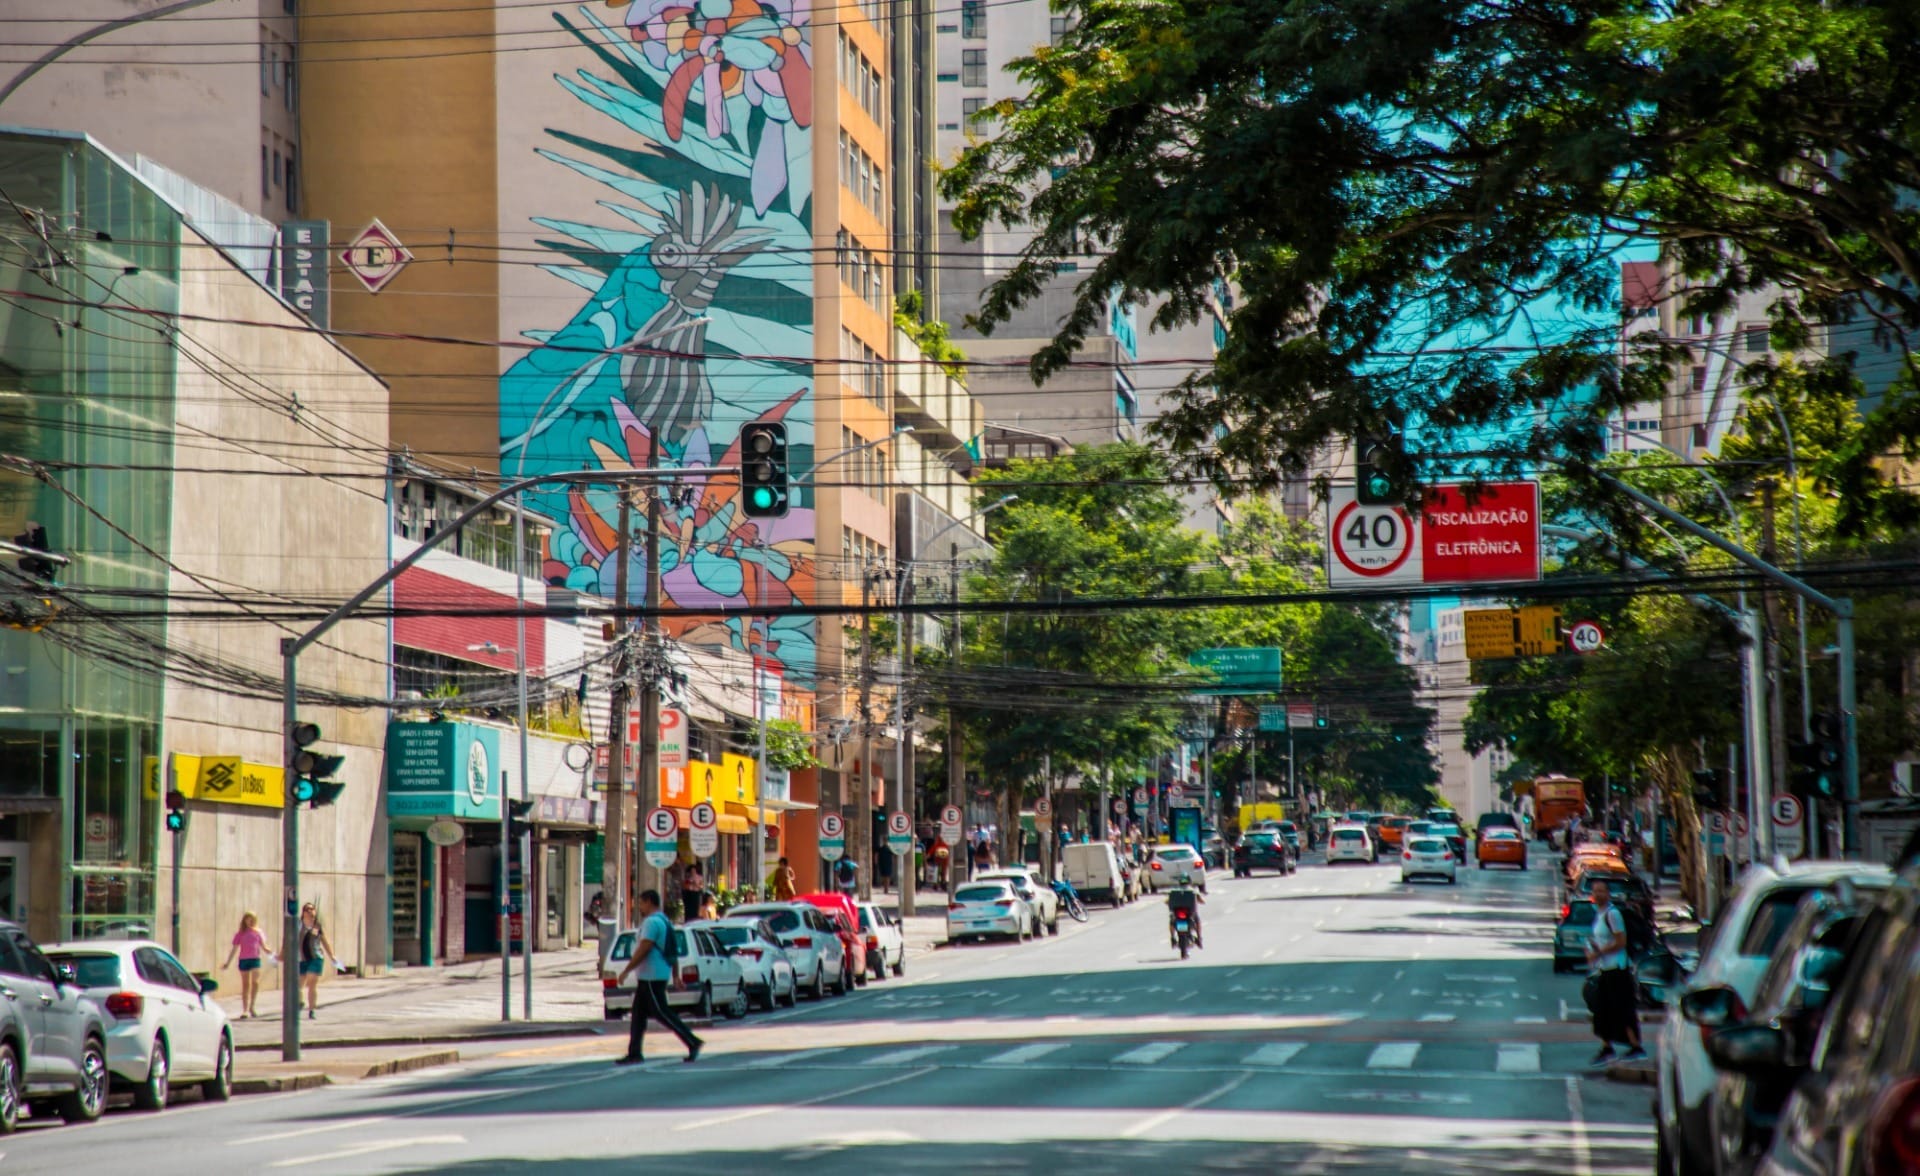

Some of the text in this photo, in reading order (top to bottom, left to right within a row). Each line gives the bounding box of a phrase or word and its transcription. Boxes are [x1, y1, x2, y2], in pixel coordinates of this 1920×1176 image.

[367, 246, 385, 267] E
[1346, 514, 1397, 549] 40
[1436, 538, 1522, 556] ELETRÔNICA
[1360, 556, 1388, 565] km/h
[1467, 613, 1512, 623] ATENÇÃO
[1576, 628, 1599, 644] 40
[698, 808, 708, 823] E
[947, 810, 955, 822] E
[1781, 801, 1792, 819] E
[656, 814, 667, 831] E
[827, 818, 836, 831] E
[896, 816, 904, 828] E
